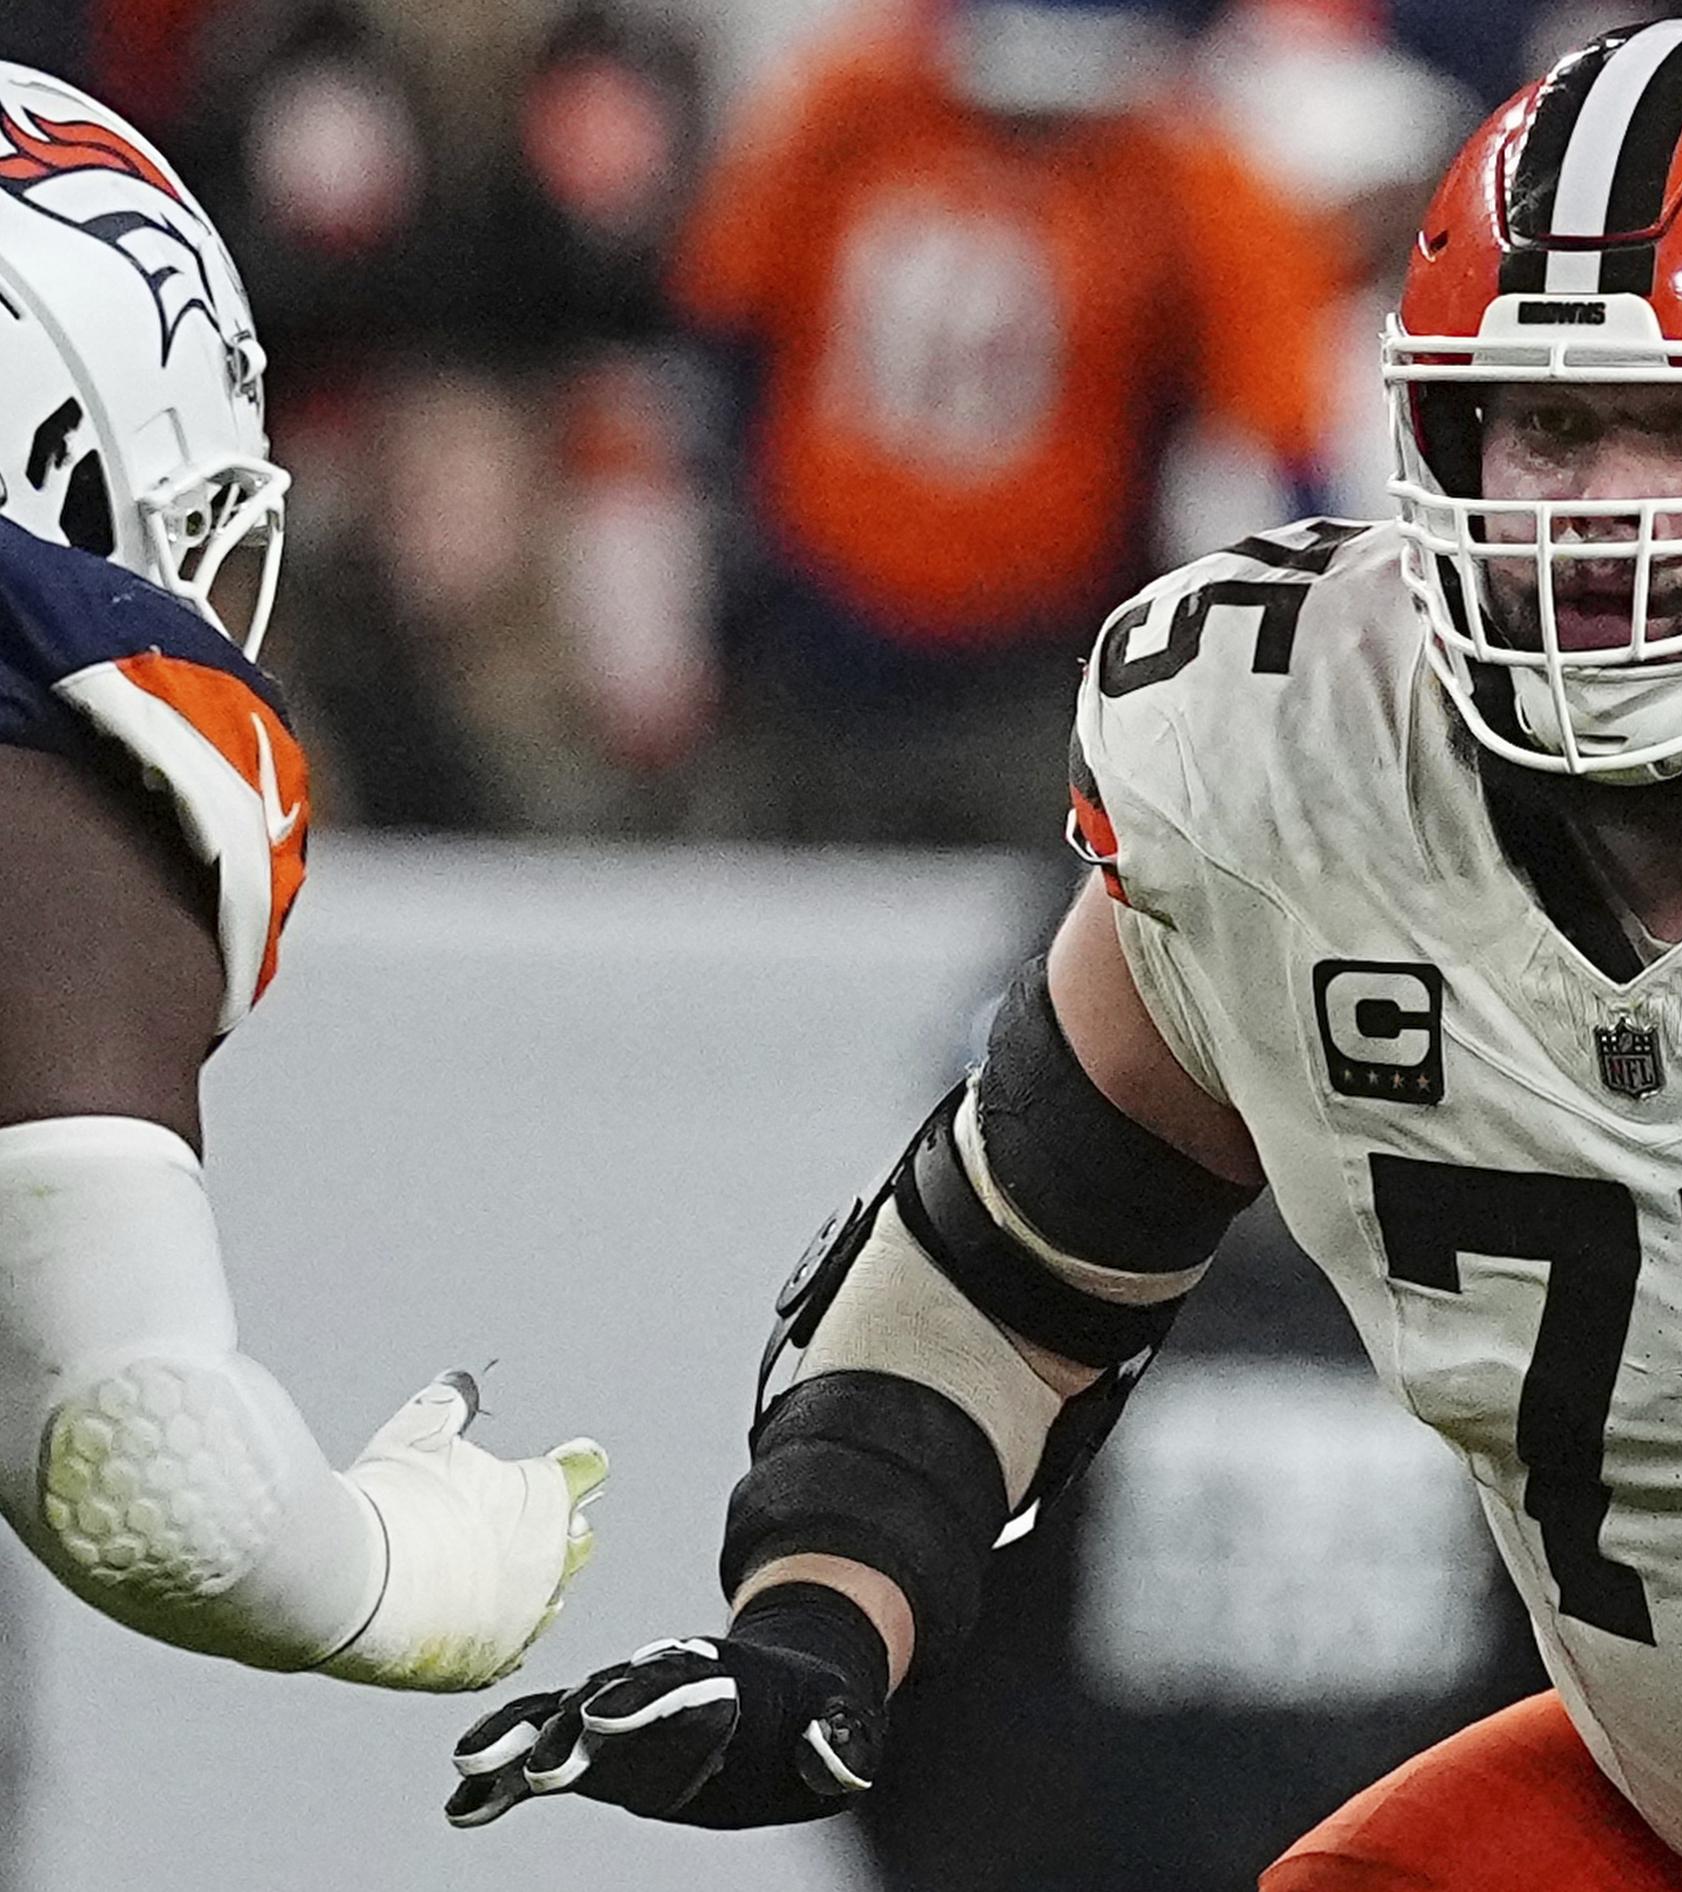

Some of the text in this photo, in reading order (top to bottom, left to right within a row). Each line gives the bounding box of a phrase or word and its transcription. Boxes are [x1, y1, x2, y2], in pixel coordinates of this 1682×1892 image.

[1101, 521, 1373, 698] 75
[1325, 971, 1431, 1067] C
[1608, 1057, 1655, 1089] NFL
